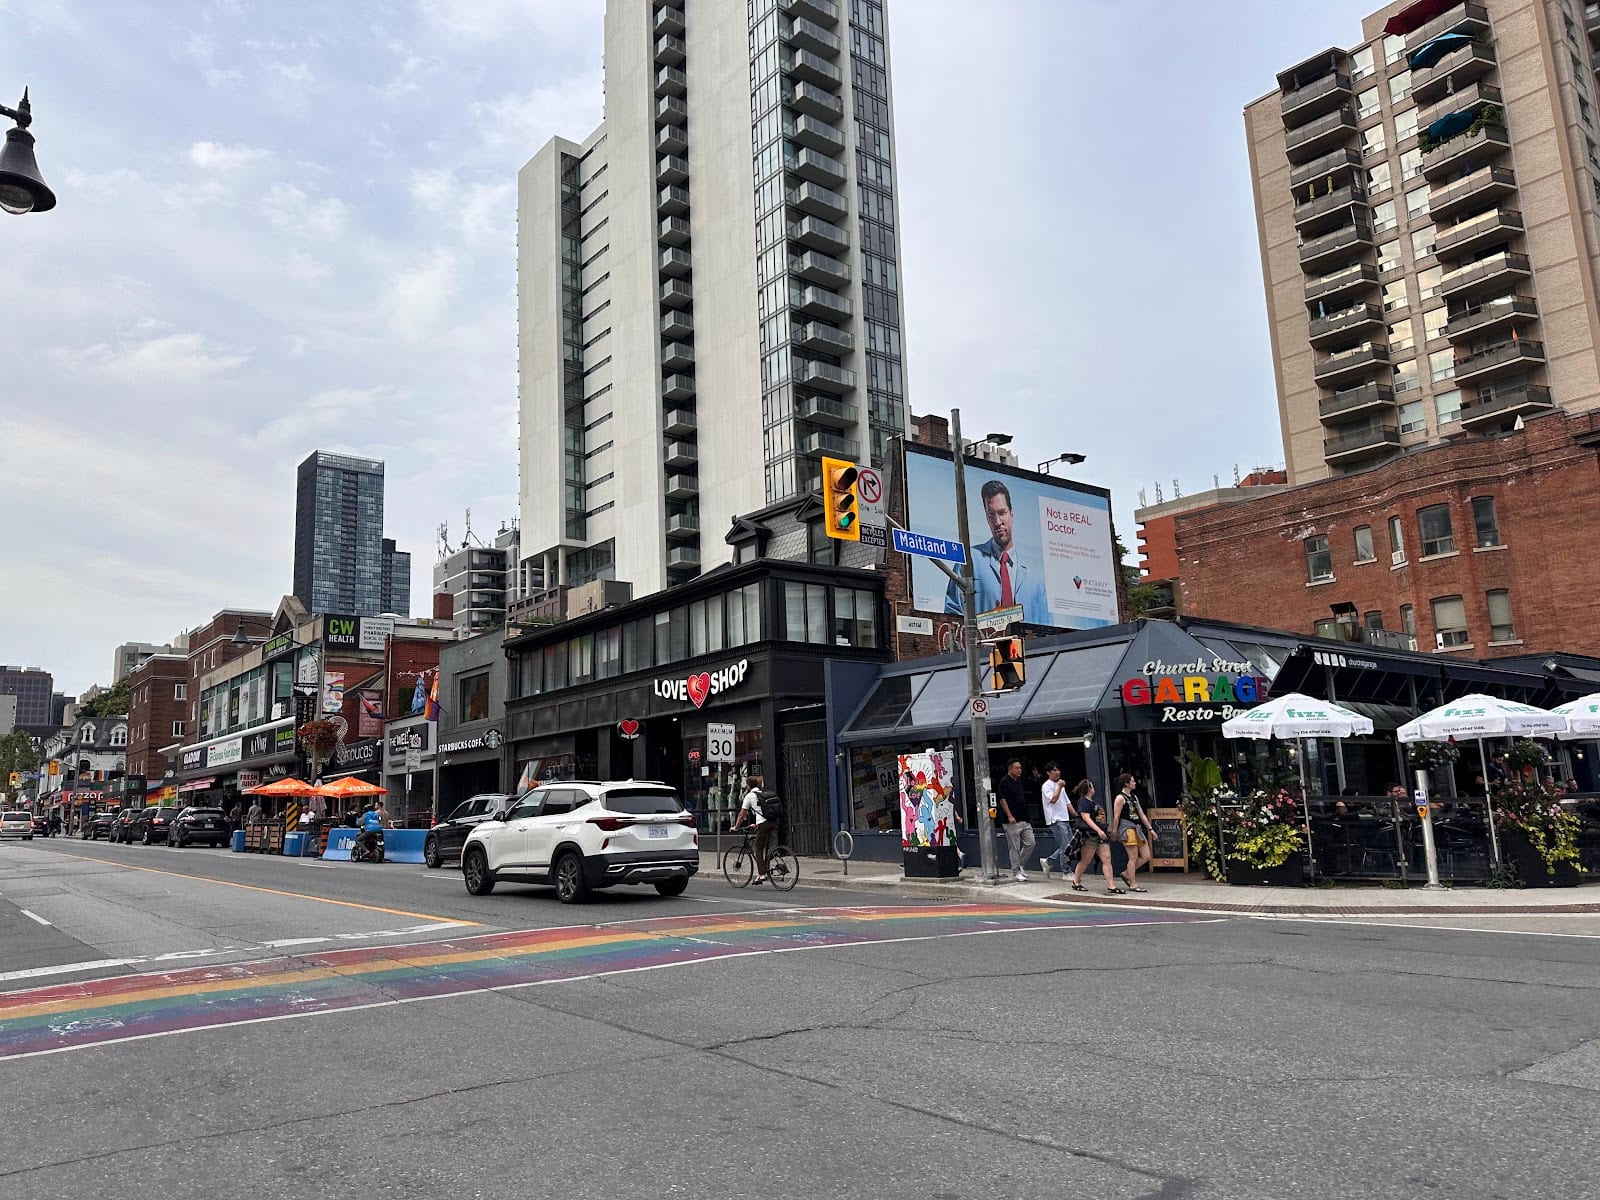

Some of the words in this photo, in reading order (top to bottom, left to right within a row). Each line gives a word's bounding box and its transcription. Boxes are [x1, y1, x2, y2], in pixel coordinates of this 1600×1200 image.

[1046, 507, 1061, 520] Not
[1063, 513, 1068, 521] a
[1070, 513, 1092, 526] REAL
[861, 526, 884, 538] BICYCLES
[861, 535, 886, 546] EXCEPTED
[900, 532, 947, 555] Maitland
[951, 543, 958, 551] St
[329, 619, 356, 635] CW
[328, 634, 355, 643] HEALTH
[1142, 658, 1207, 676] Church
[1211, 657, 1252, 674] Street
[654, 678, 688, 701] LOVE
[710, 658, 748, 695] SHOP
[1122, 675, 1269, 705] GARAGE
[438, 740, 468, 753] STARBUCKS
[710, 739, 732, 756] 30
